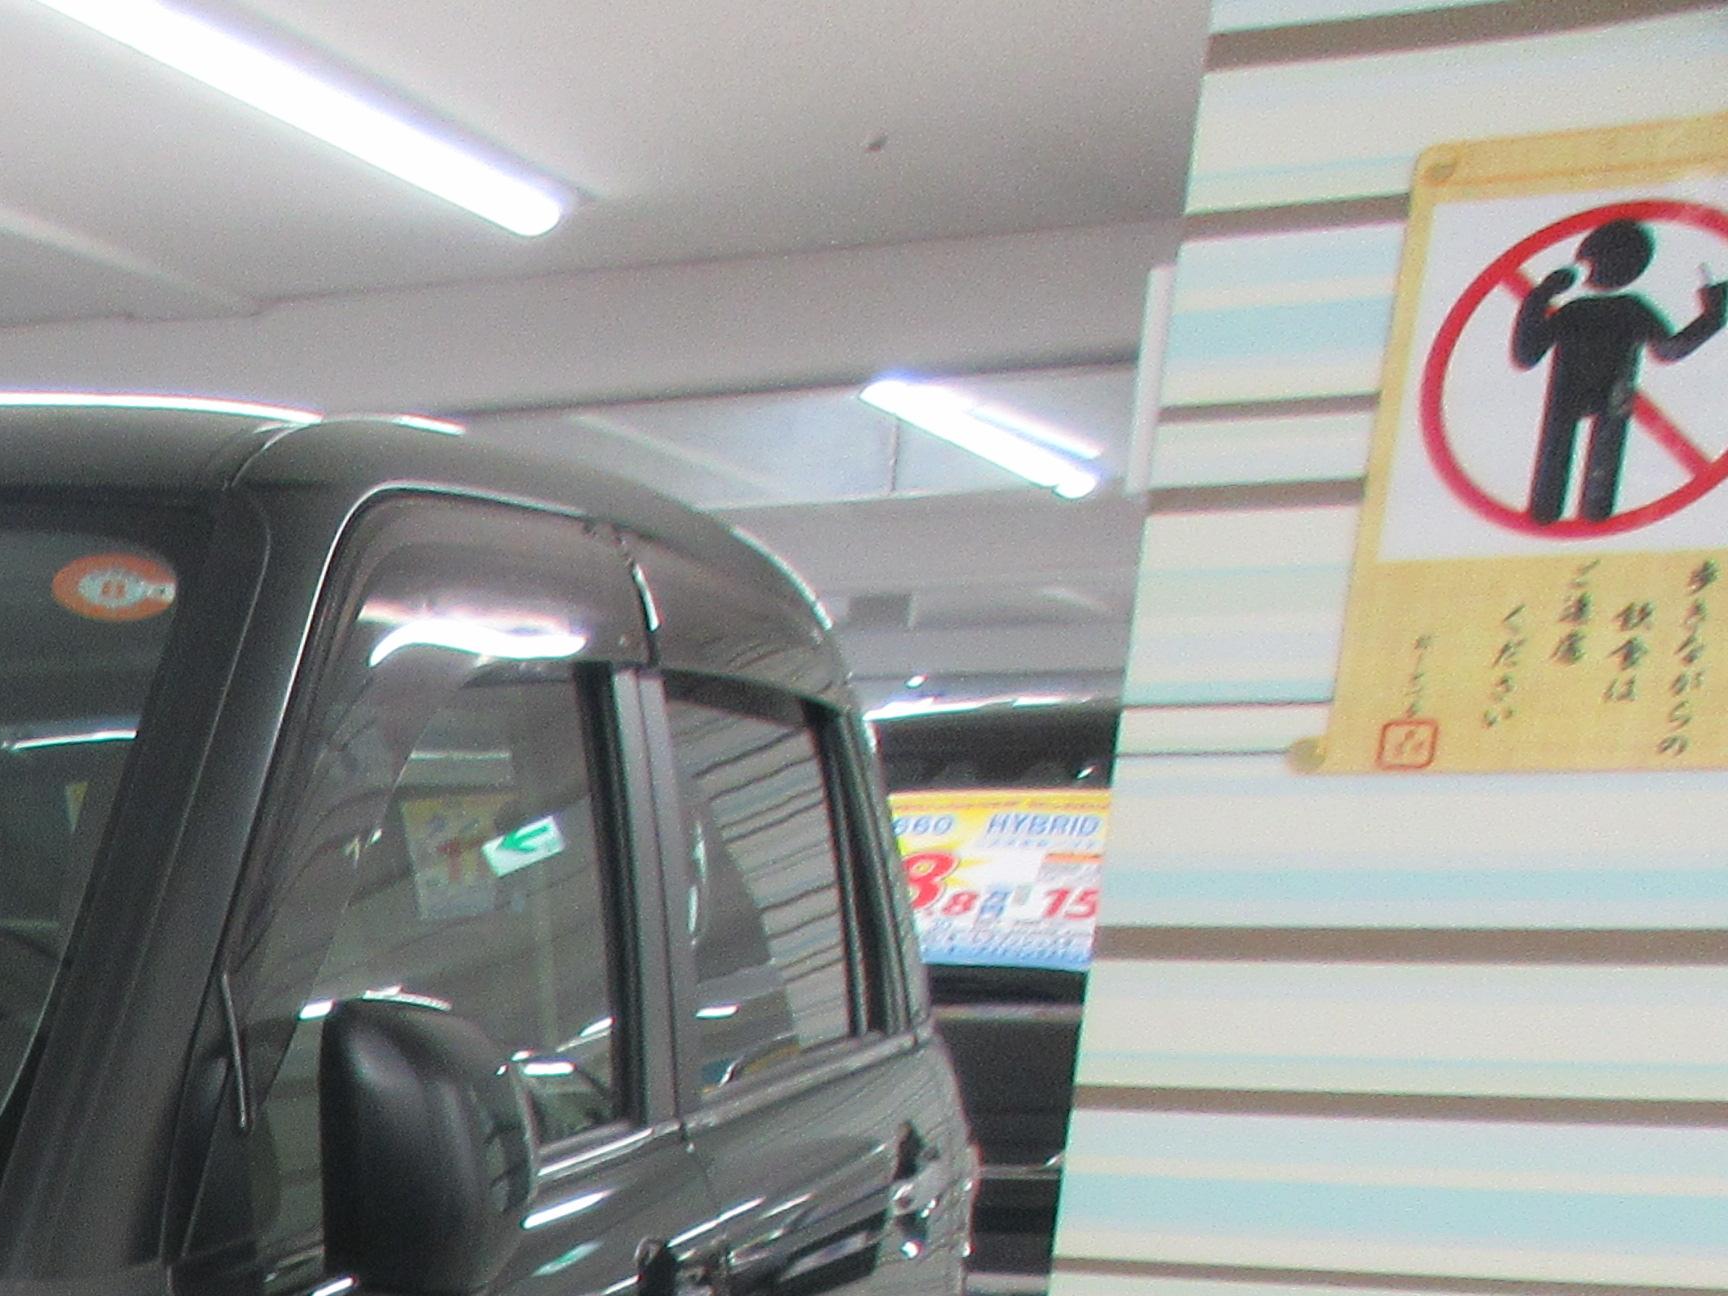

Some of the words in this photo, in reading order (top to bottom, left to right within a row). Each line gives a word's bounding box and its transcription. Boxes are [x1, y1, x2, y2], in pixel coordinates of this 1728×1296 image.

[1481, 603, 1527, 730] ください
[987, 813, 1102, 836] HYBRID
